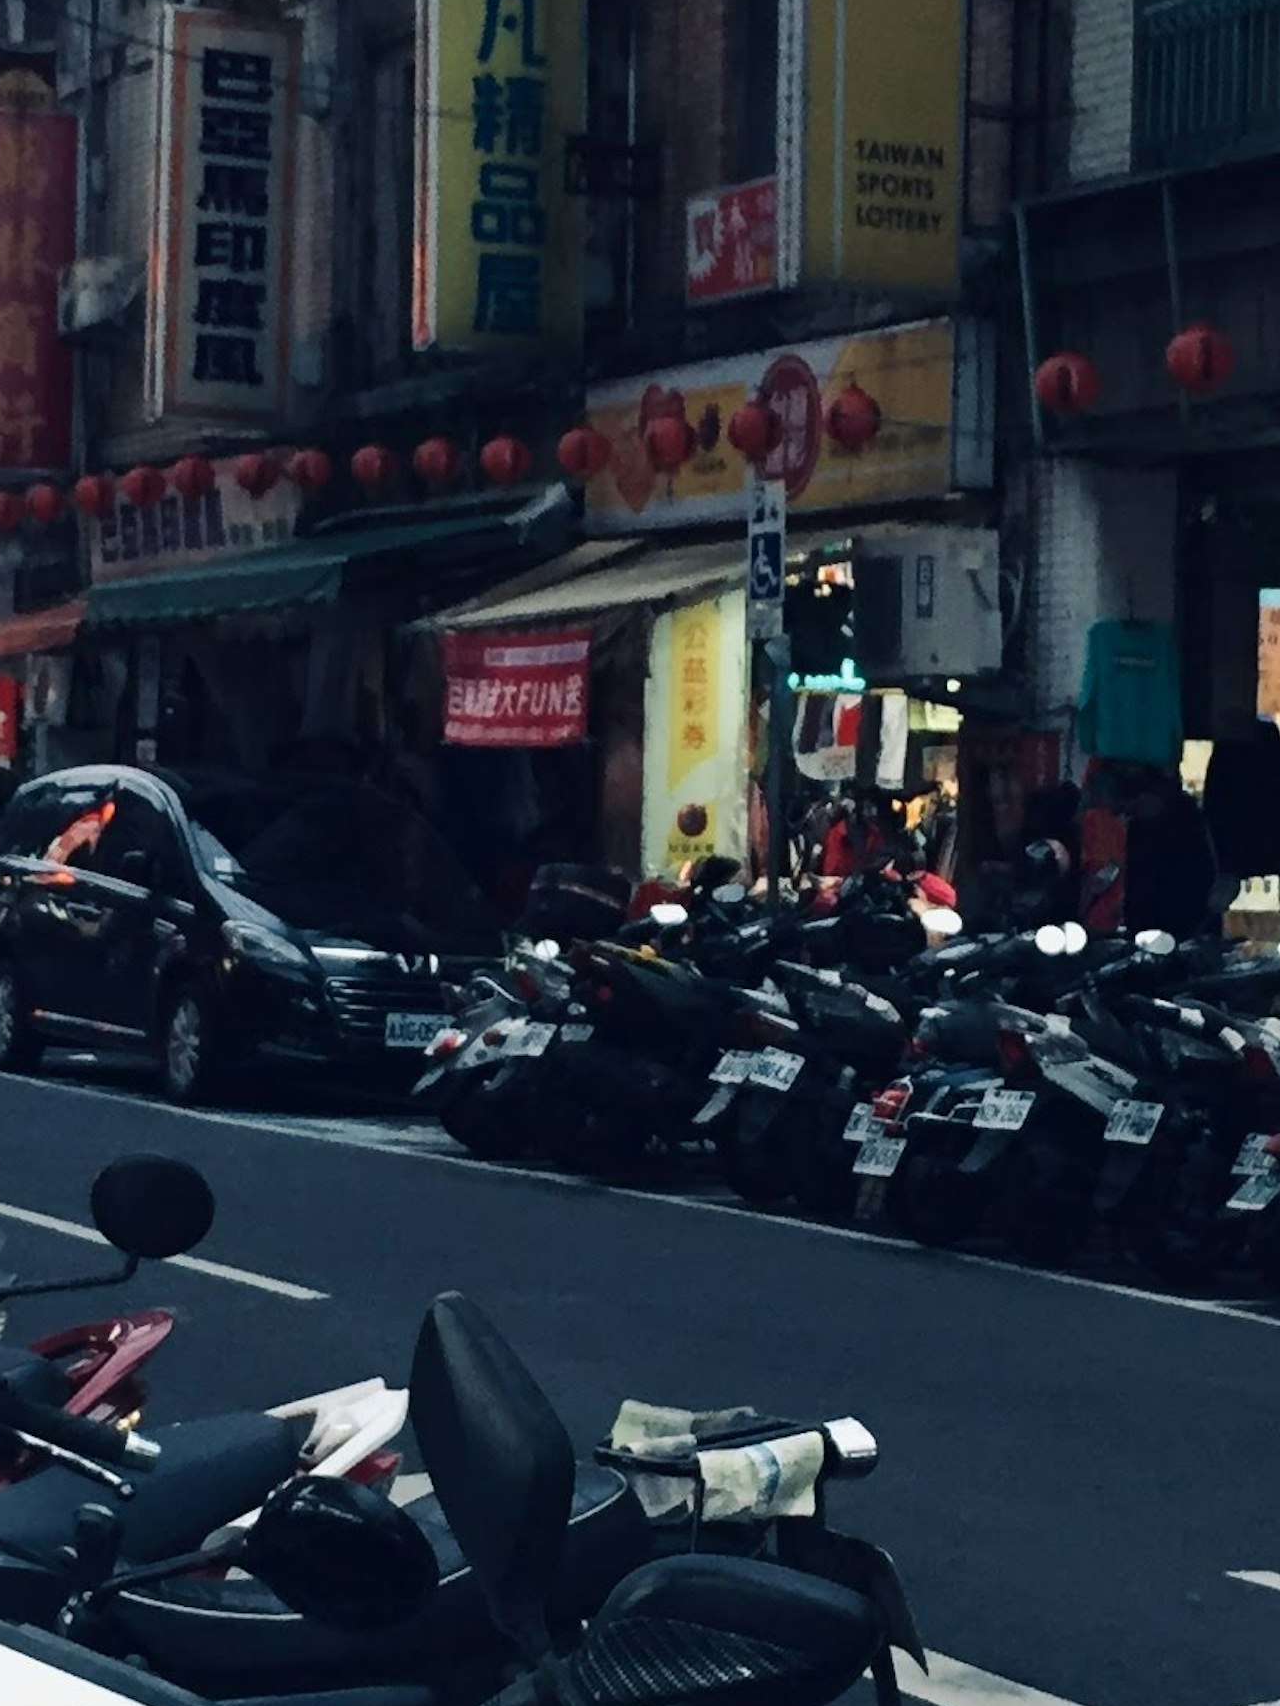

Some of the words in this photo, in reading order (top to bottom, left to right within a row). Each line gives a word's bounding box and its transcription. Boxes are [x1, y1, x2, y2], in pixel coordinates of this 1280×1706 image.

[855, 139, 944, 170] TAIWAN
[856, 173, 935, 202] SPORTS
[856, 204, 944, 234] LOTTERY
